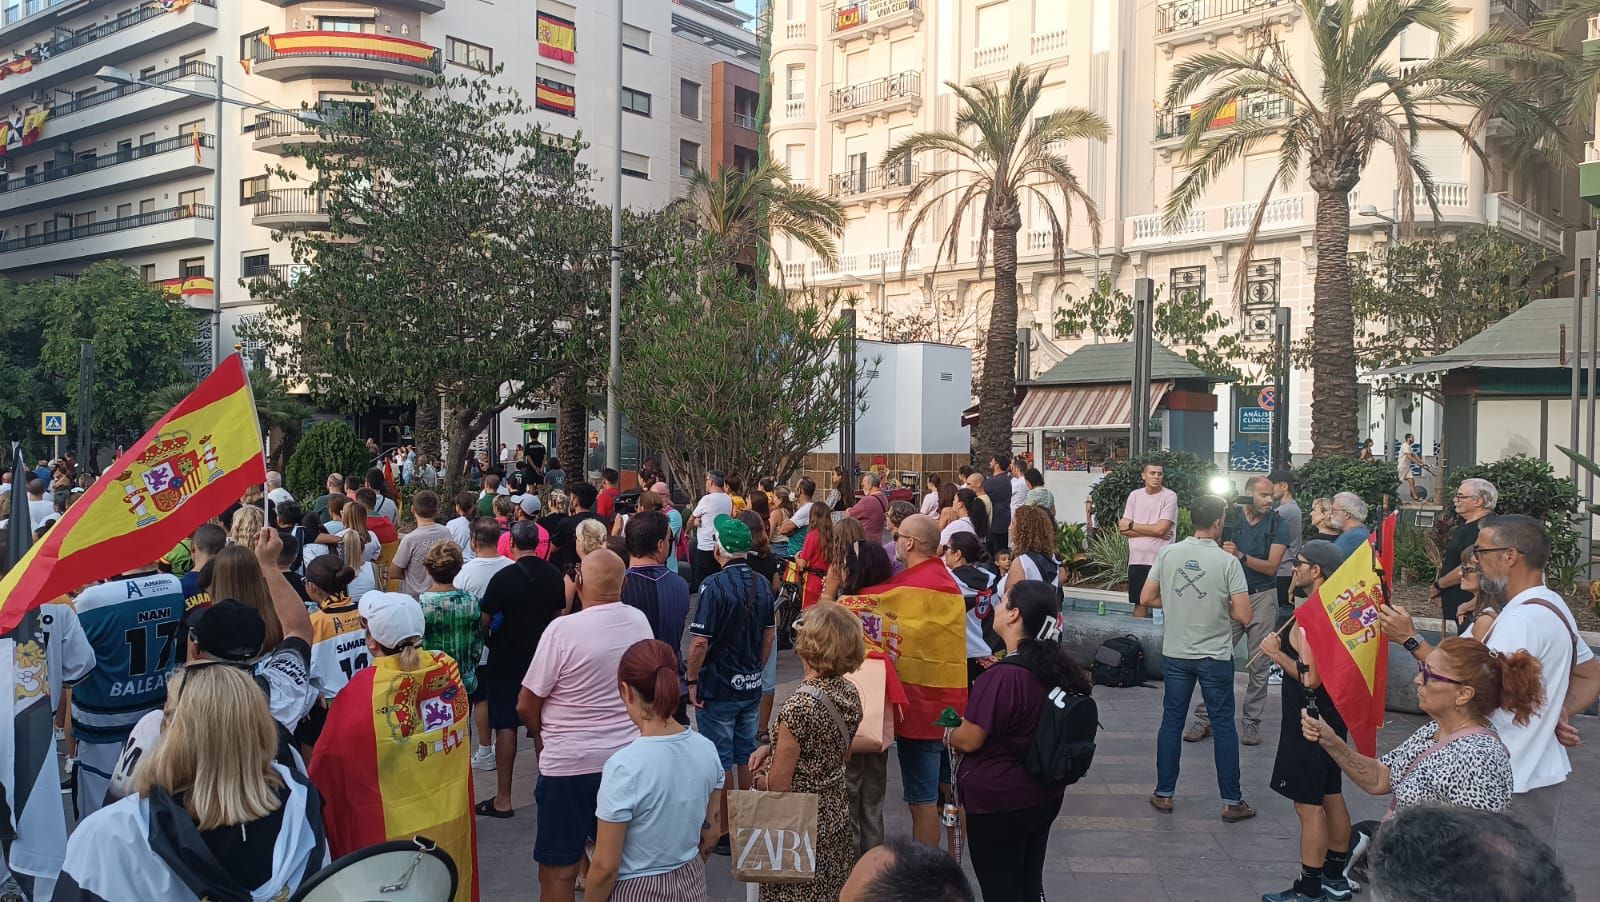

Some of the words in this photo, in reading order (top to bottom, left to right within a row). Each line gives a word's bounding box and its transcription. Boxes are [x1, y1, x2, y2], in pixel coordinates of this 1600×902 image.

[1243, 410, 1274, 418] ANÁLIS
[137, 607, 172, 624] NANI
[125, 619, 181, 677] 17
[110, 671, 171, 697] BALEA
[736, 828, 816, 873] ZARA
